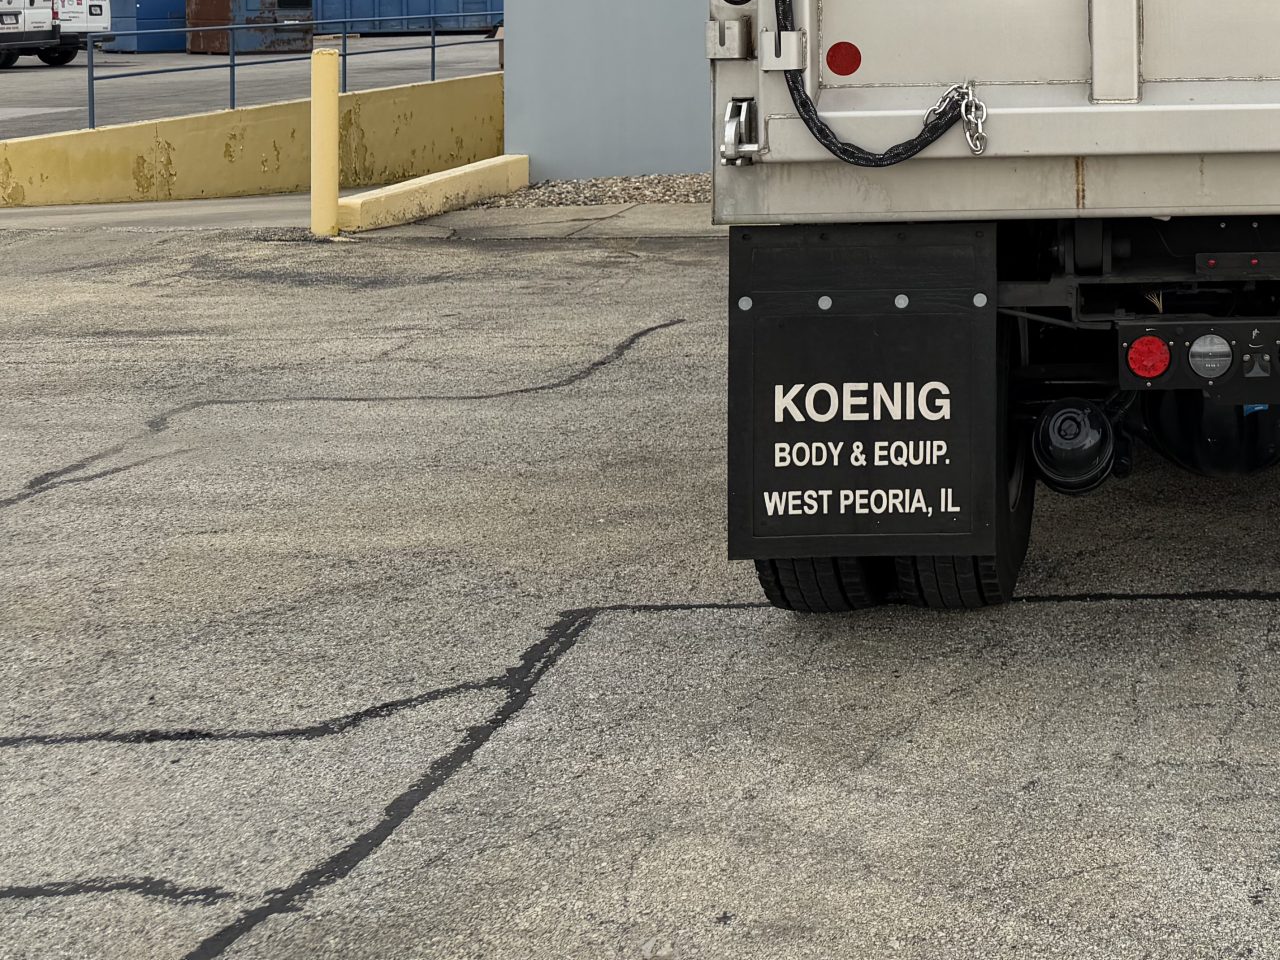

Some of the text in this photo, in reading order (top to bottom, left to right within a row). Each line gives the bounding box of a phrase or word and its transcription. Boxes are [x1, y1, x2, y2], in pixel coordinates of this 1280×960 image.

[774, 381, 951, 423] KOENIG
[774, 440, 950, 467] BODY & EQUIP.
[763, 488, 961, 517] WEST PEORIA, IL
